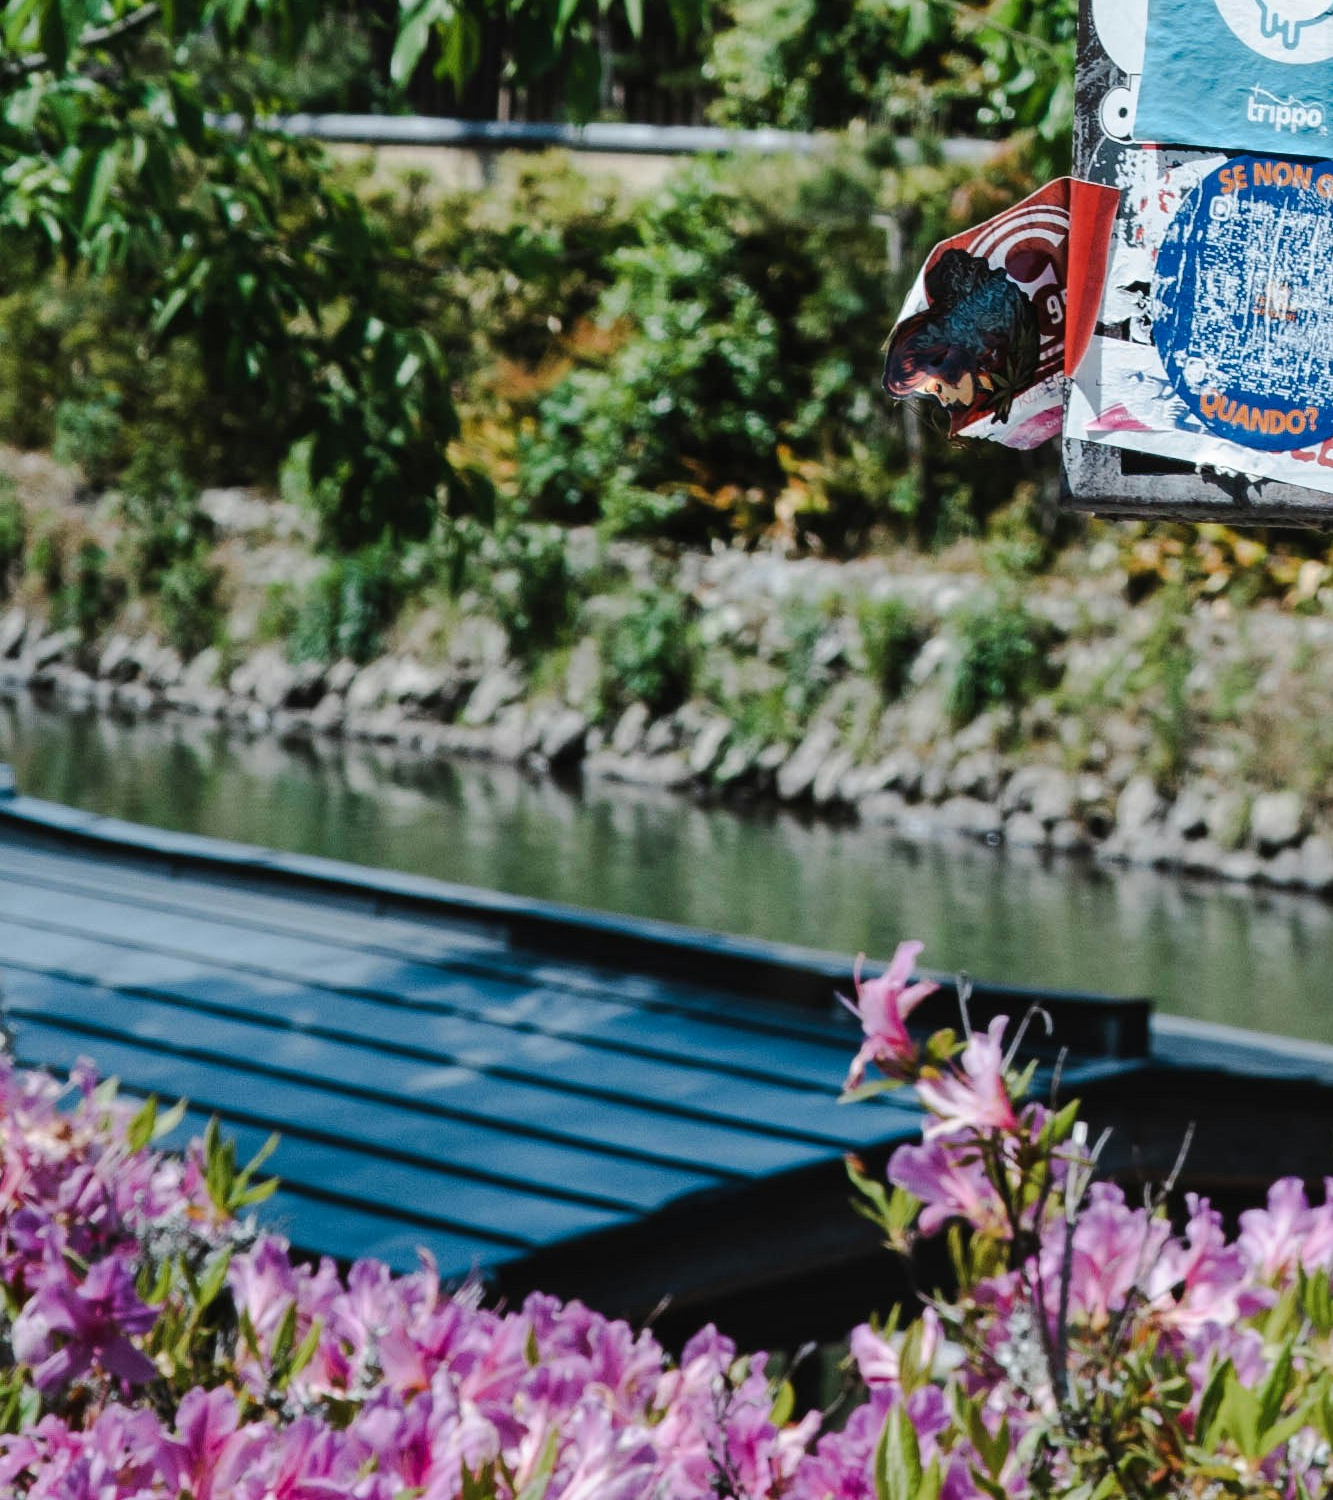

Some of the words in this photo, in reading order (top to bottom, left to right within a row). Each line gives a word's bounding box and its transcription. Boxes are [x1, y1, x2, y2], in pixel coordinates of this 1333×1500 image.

[1247, 96, 1324, 134] trippo
[1218, 164, 1248, 194] SE
[1254, 161, 1312, 190] NON
[1199, 389, 1319, 435] QUANDO?
